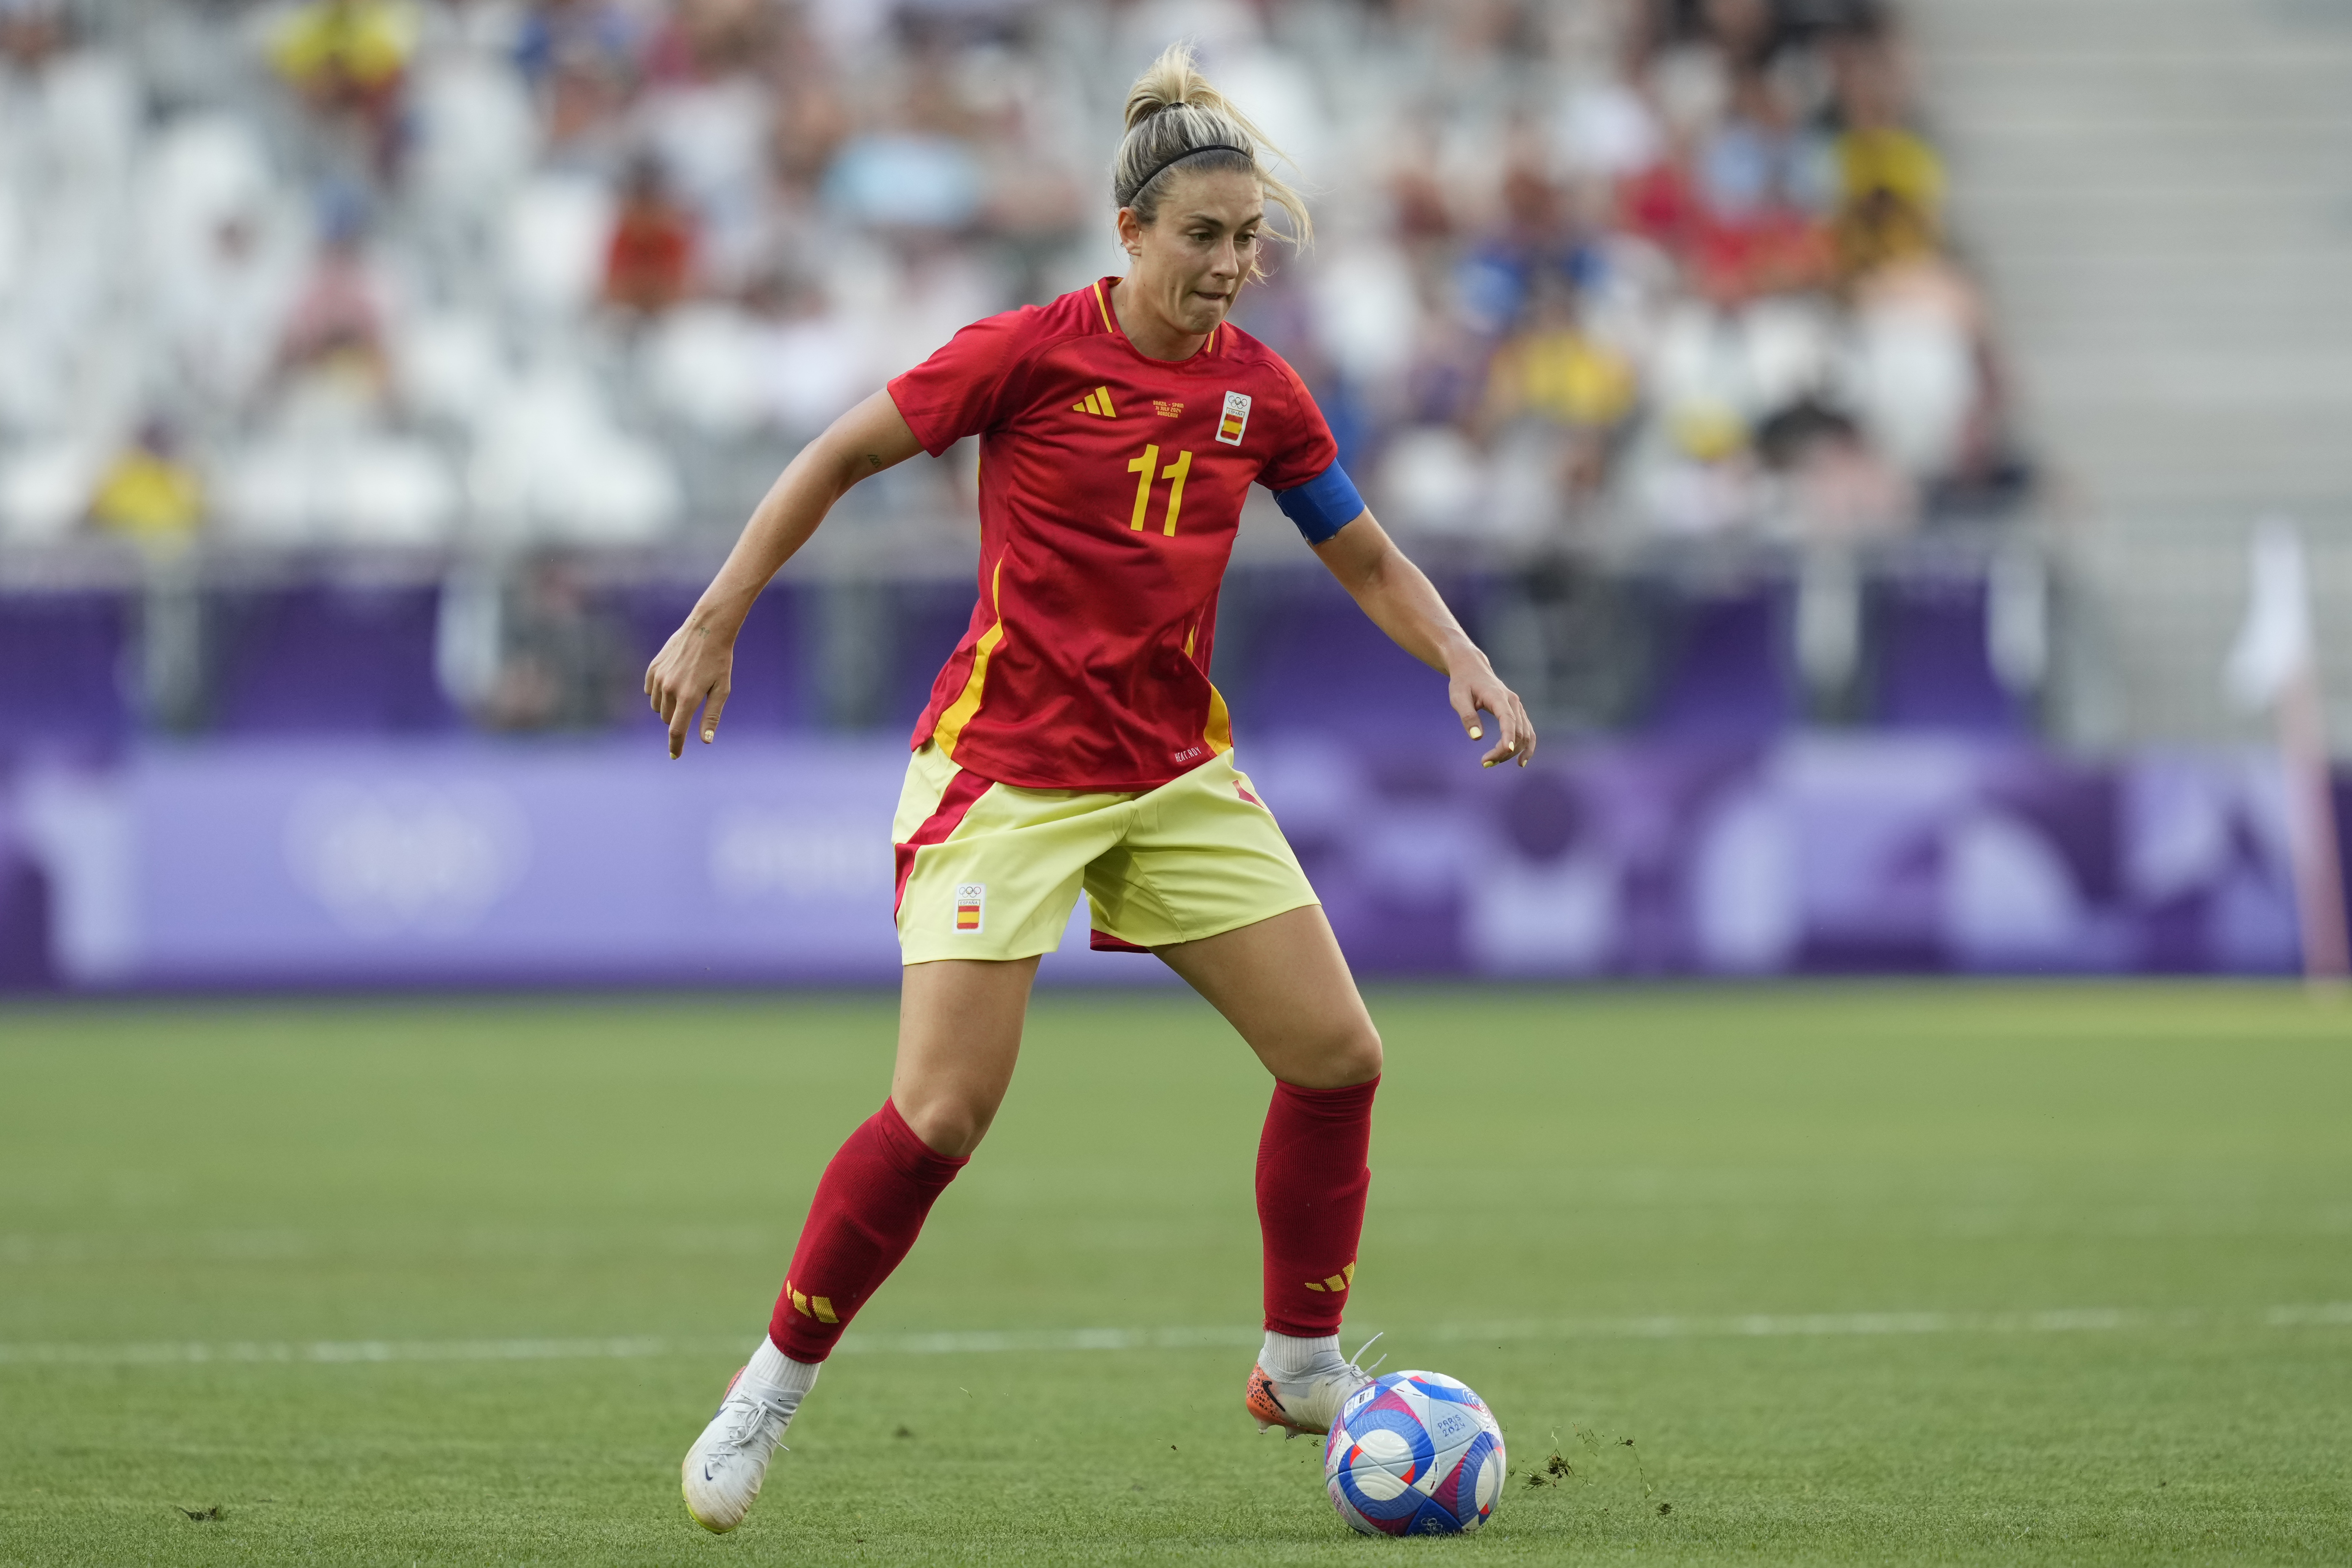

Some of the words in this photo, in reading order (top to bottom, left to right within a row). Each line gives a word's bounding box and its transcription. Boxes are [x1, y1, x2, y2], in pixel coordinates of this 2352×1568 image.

[1127, 444, 1192, 537] 11
[1175, 747, 1201, 762] HEAT.RDY
[1438, 1415, 1461, 1429] PARIS
[1442, 1422, 1465, 1437] 2024
